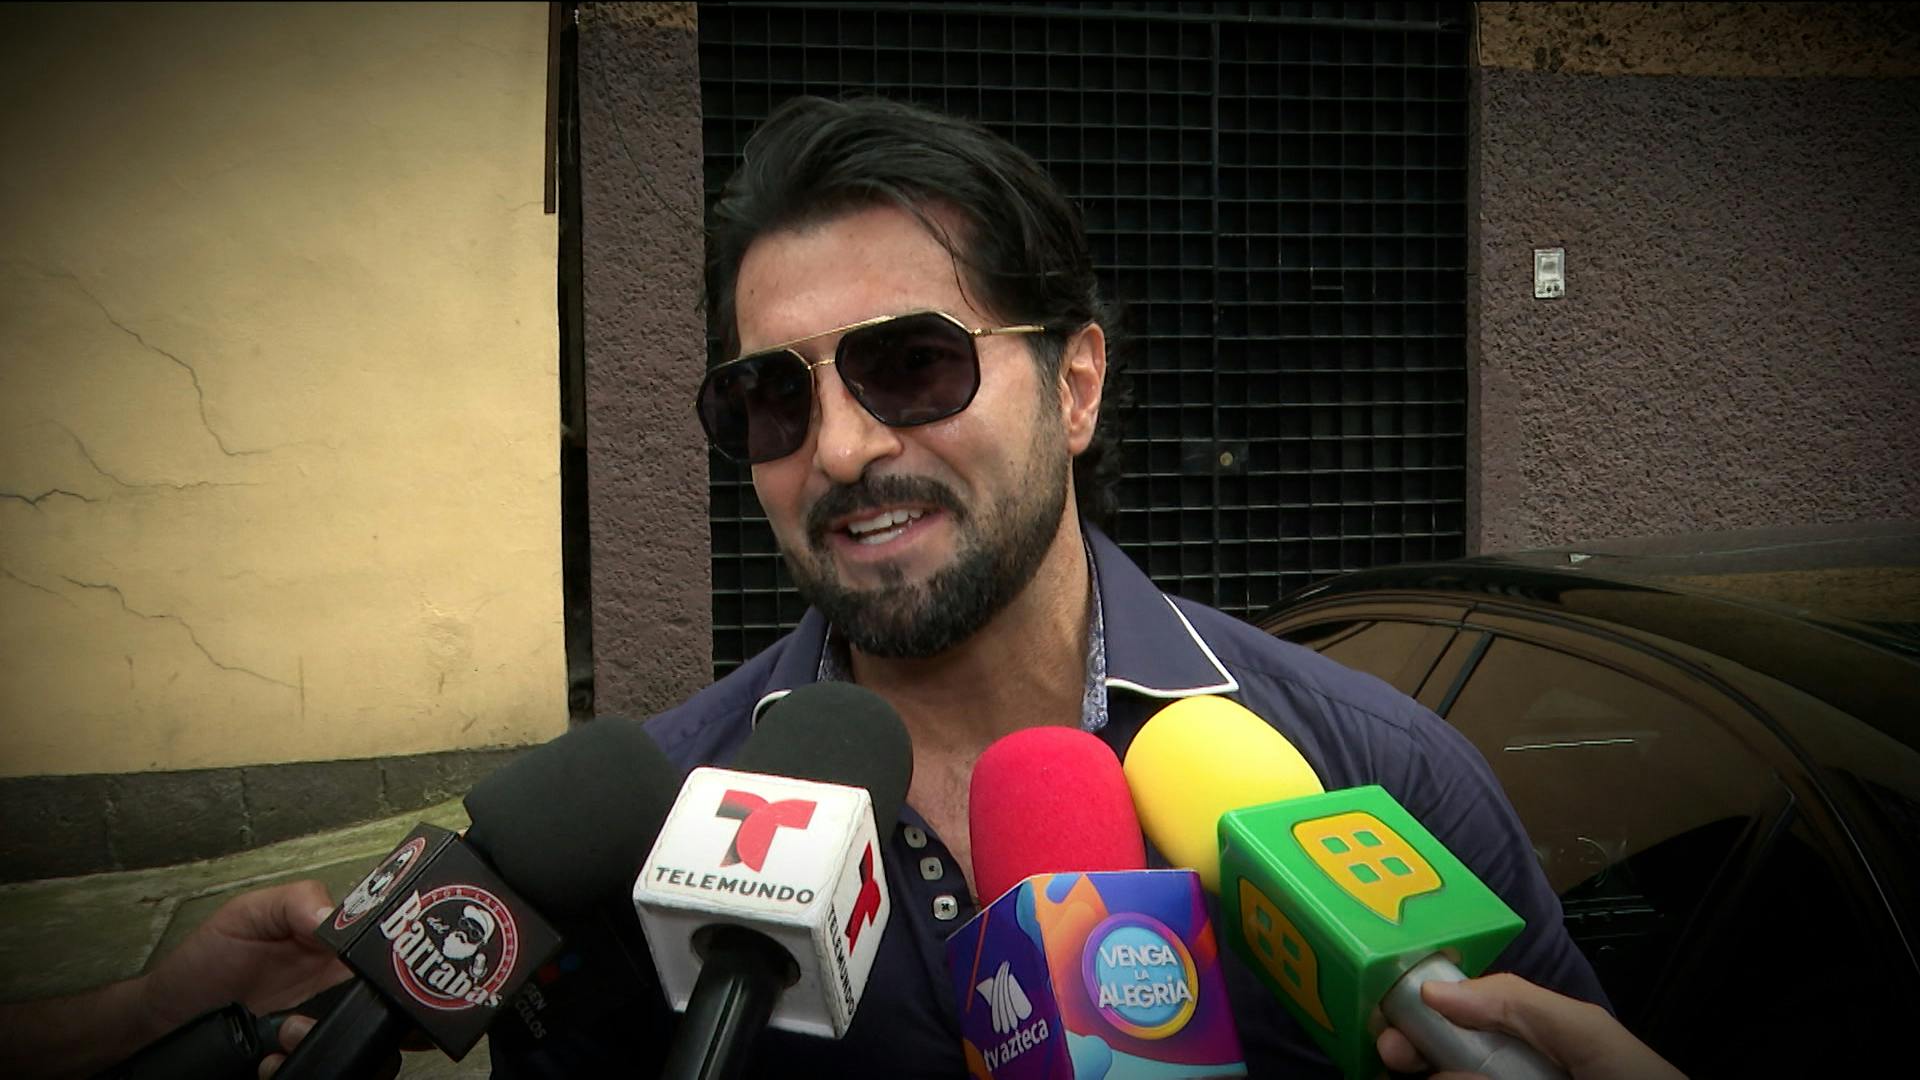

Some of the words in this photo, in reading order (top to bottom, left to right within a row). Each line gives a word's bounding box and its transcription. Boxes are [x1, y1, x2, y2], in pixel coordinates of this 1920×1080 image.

[655, 866, 815, 904] TELEMUNDO
[827, 902, 855, 1016] TELEMUNDO
[1100, 944, 1178, 969] VENGA
[1134, 969, 1150, 981] LA
[1000, 1017, 1050, 1065] azteca
